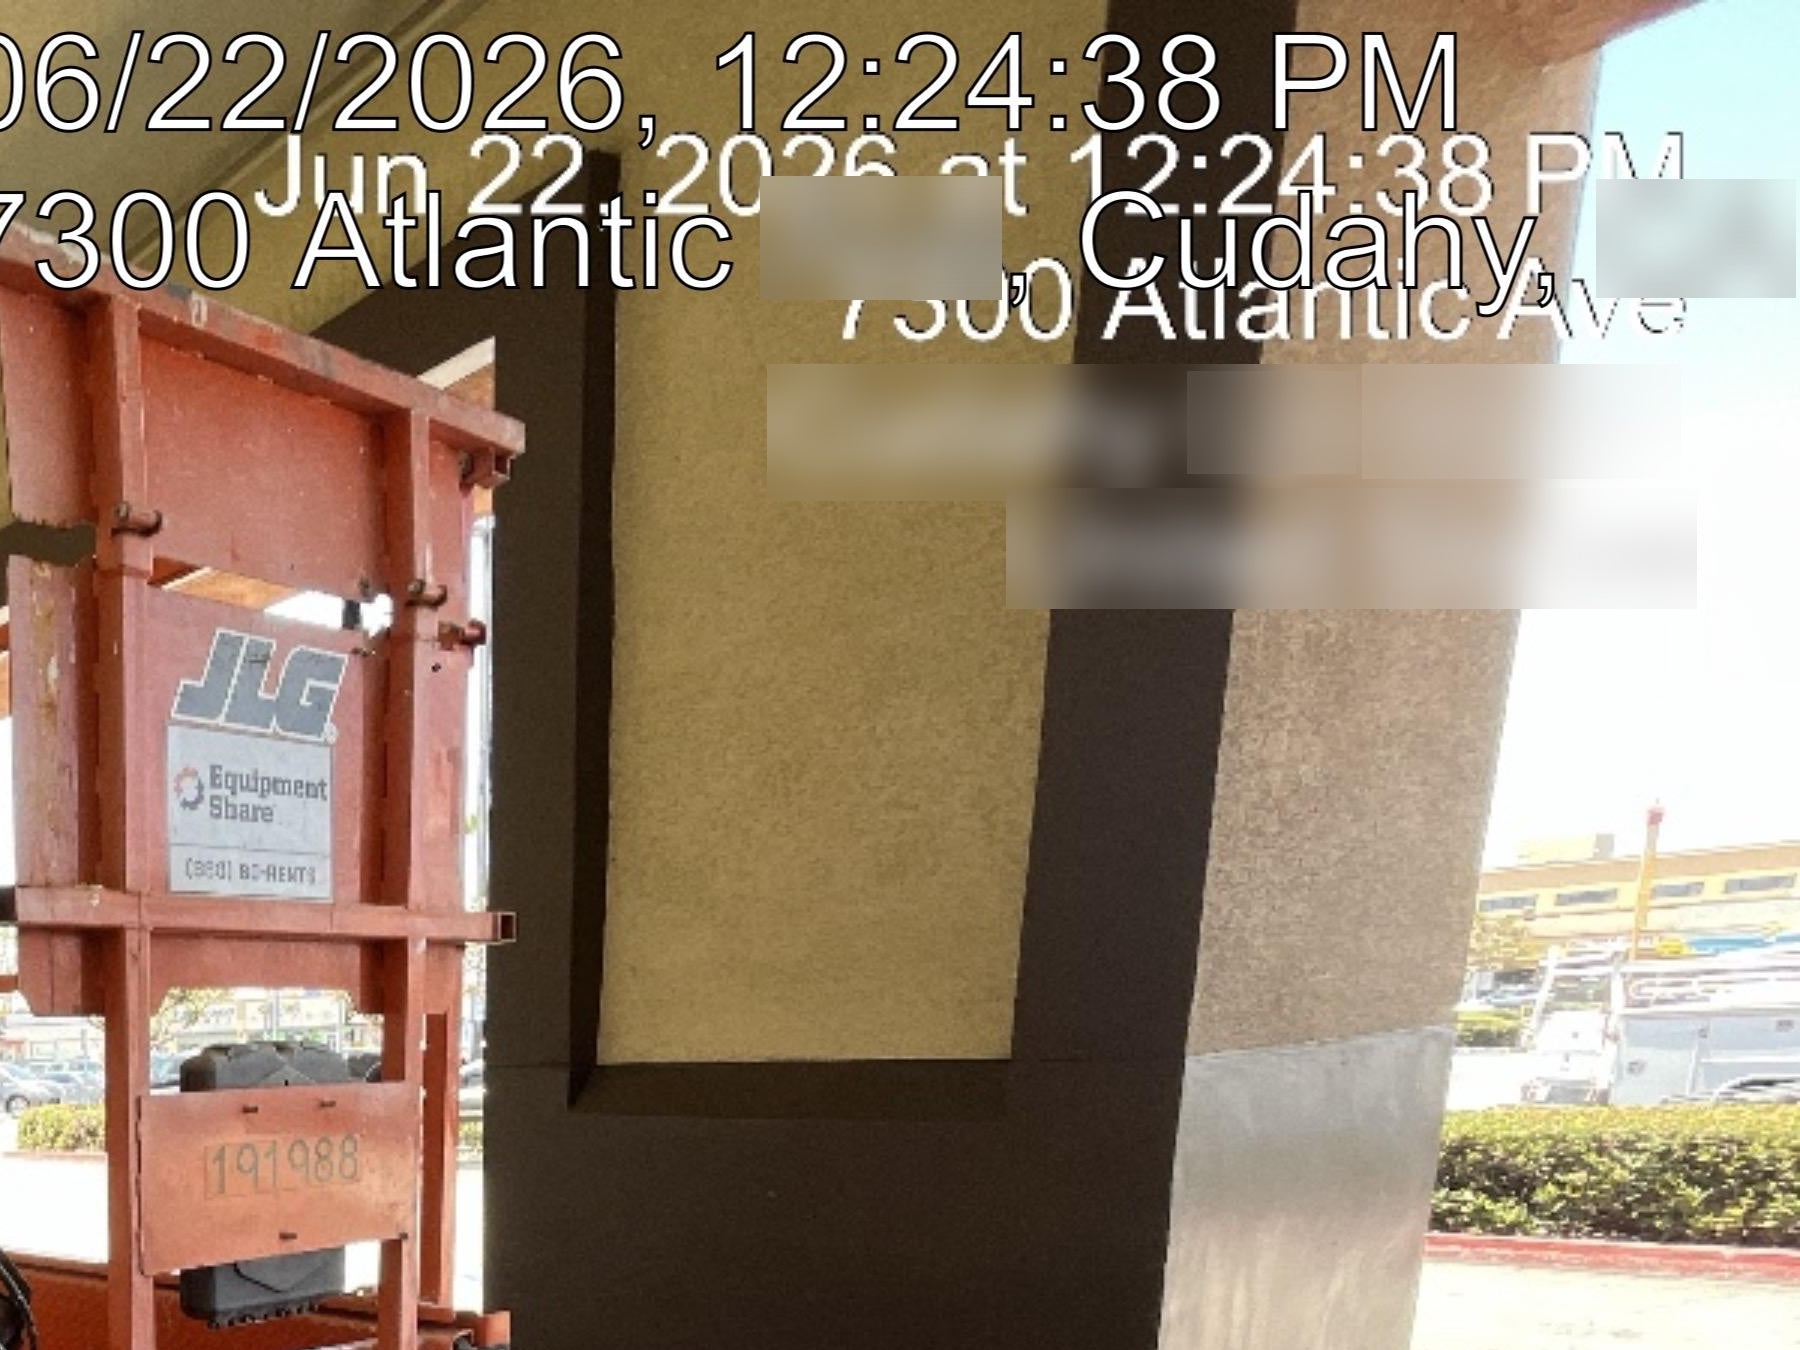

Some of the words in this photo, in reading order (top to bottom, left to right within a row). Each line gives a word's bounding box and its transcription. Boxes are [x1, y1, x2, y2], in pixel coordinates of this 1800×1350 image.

[171, 627, 349, 742] JLG
[208, 764, 329, 802] Equipment
[208, 794, 275, 824] Share
[212, 1132, 359, 1195] 191988
